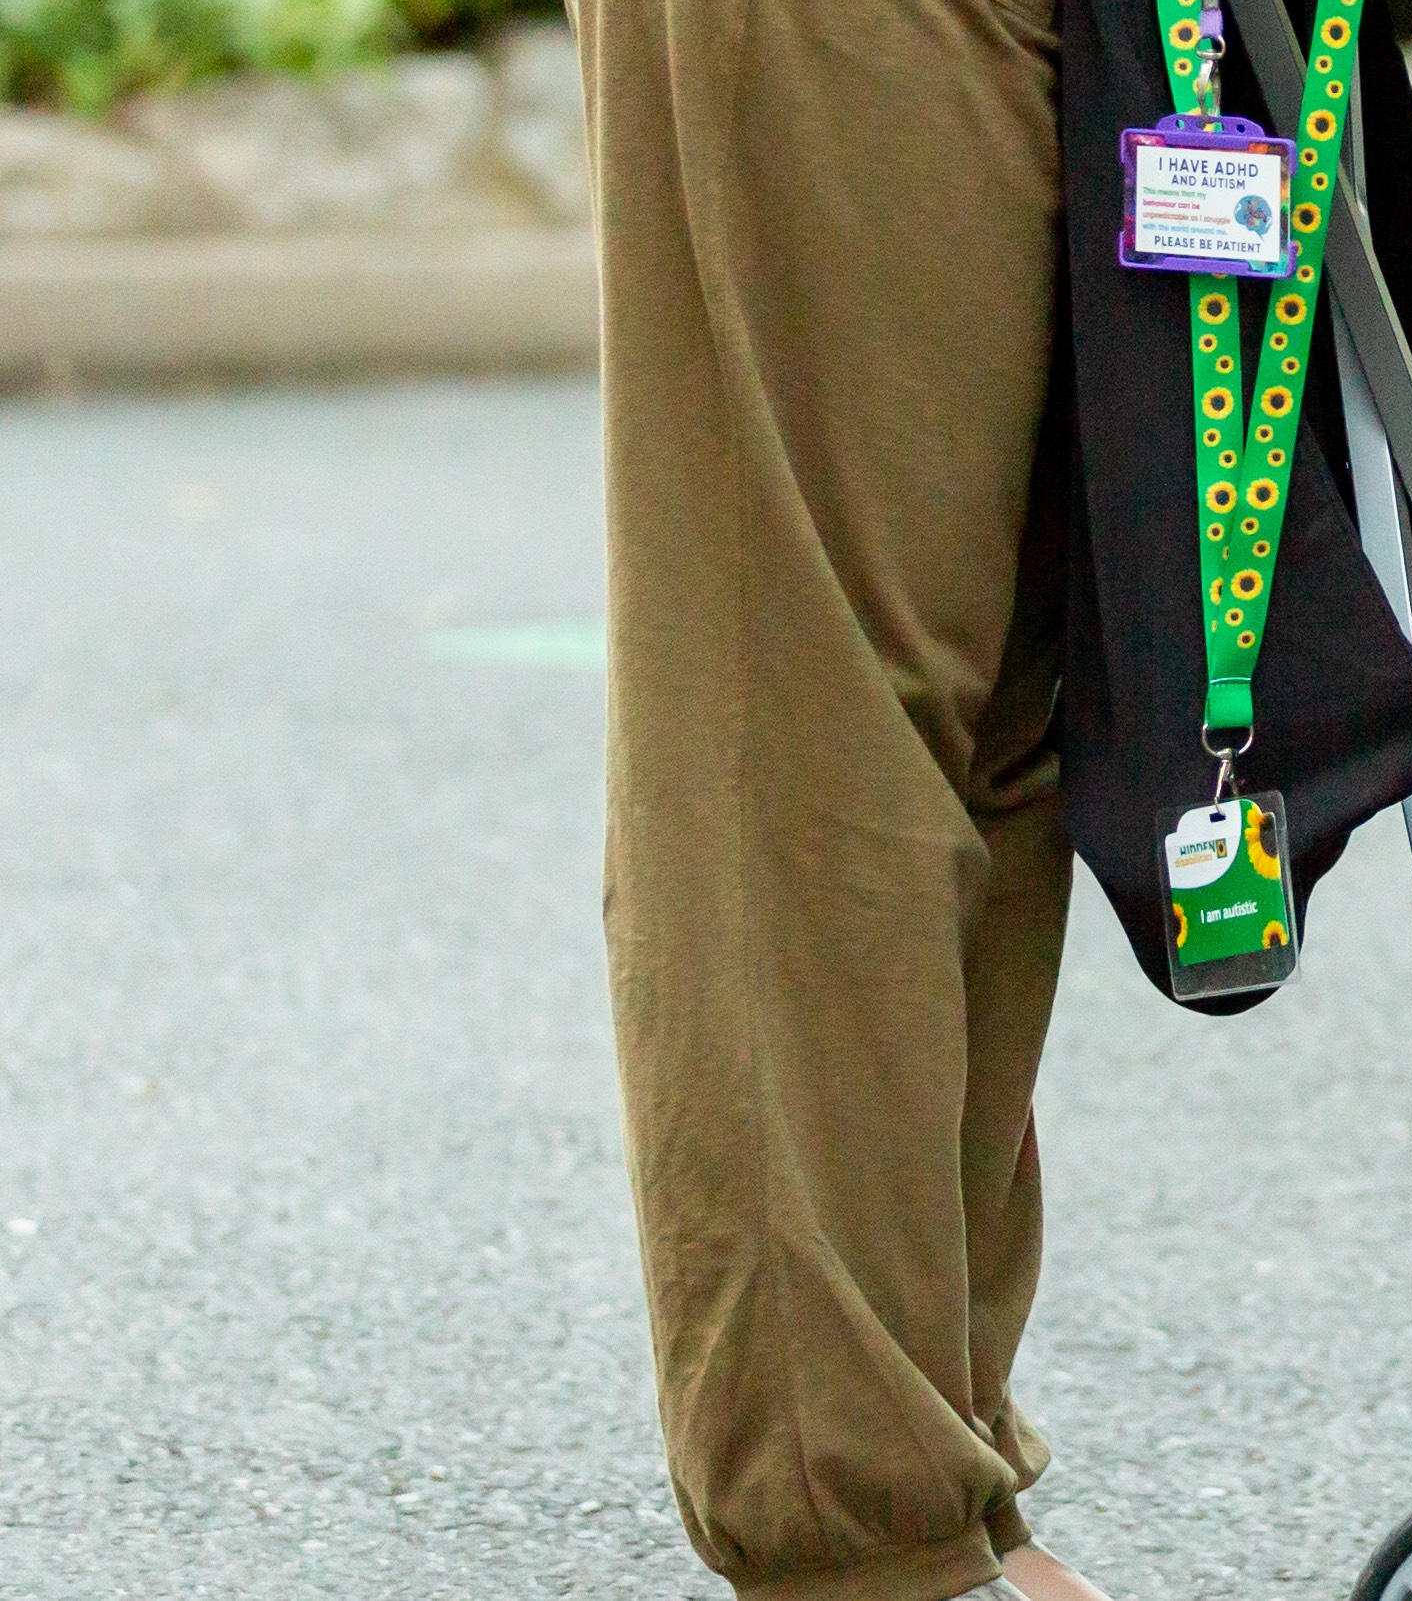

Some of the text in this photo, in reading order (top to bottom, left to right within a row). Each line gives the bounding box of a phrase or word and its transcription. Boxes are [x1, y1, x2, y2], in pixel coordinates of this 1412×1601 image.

[1169, 158, 1209, 174] HAVE
[1215, 161, 1259, 177] ADHD
[1171, 175, 1246, 190] AND AUTISM
[1154, 236, 1261, 253] PLEASE BE PATIENT
[1206, 909, 1221, 923] am
[1223, 900, 1258, 919] autistic
